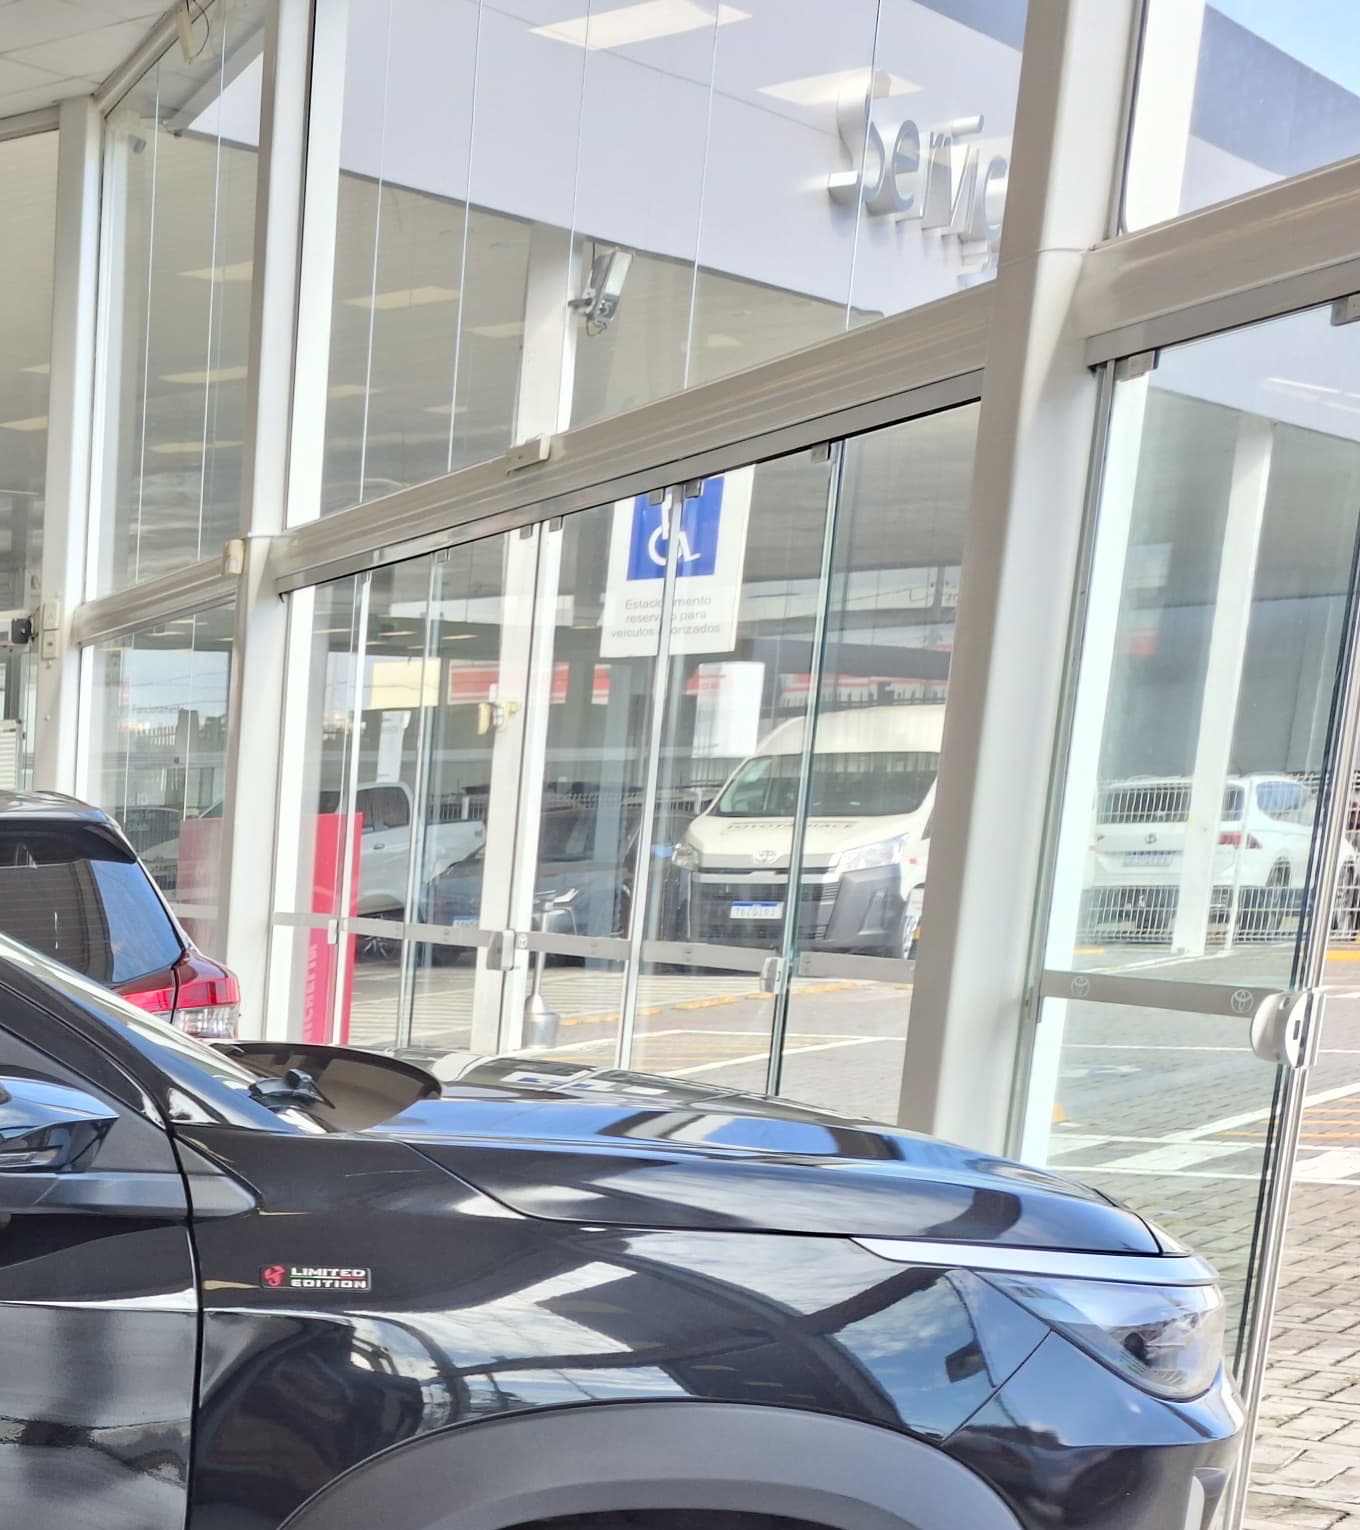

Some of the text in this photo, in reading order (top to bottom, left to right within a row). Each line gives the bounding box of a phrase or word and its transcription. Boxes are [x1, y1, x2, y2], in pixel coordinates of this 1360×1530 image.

[828, 70, 1009, 285] Serviç
[290, 1267, 366, 1277] LIMITED
[290, 1279, 367, 1288] EDITION
